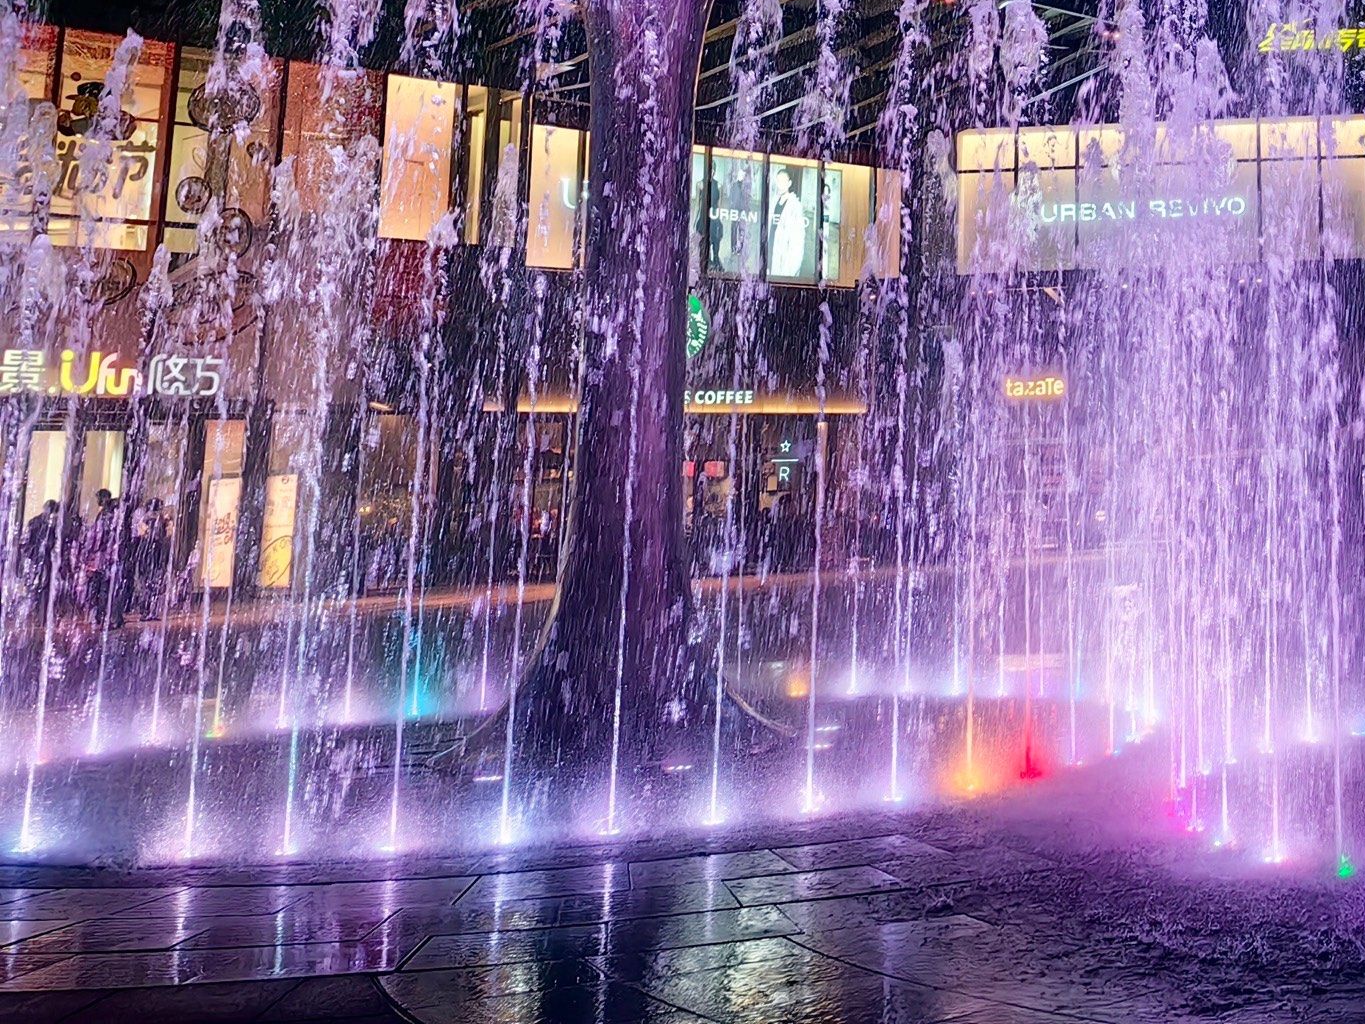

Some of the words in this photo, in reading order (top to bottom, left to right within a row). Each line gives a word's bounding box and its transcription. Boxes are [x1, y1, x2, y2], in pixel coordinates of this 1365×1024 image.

[709, 207, 758, 224] URBAN
[1040, 200, 1136, 223] URBAN
[695, 390, 754, 404] COFFEE
[779, 467, 790, 481] R
